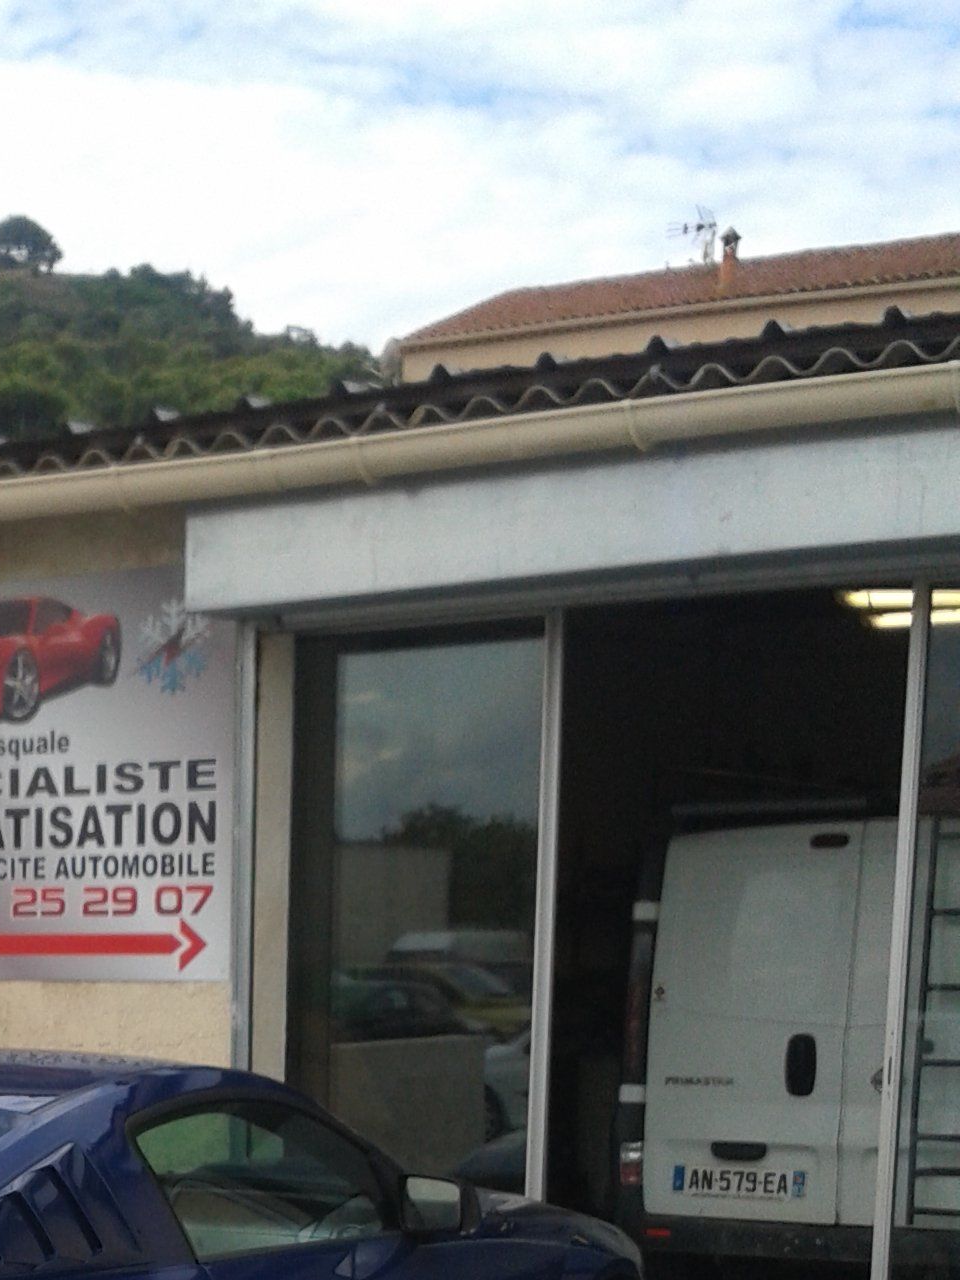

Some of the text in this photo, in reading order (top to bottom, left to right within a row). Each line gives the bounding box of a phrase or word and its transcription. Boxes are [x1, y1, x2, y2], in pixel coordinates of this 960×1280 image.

[55, 853, 215, 879] AUTOMOBILE
[12, 888, 66, 916] 25
[82, 886, 138, 916] 29
[155, 885, 214, 916] 07
[688, 1169, 788, 1194] AN-579-EA
